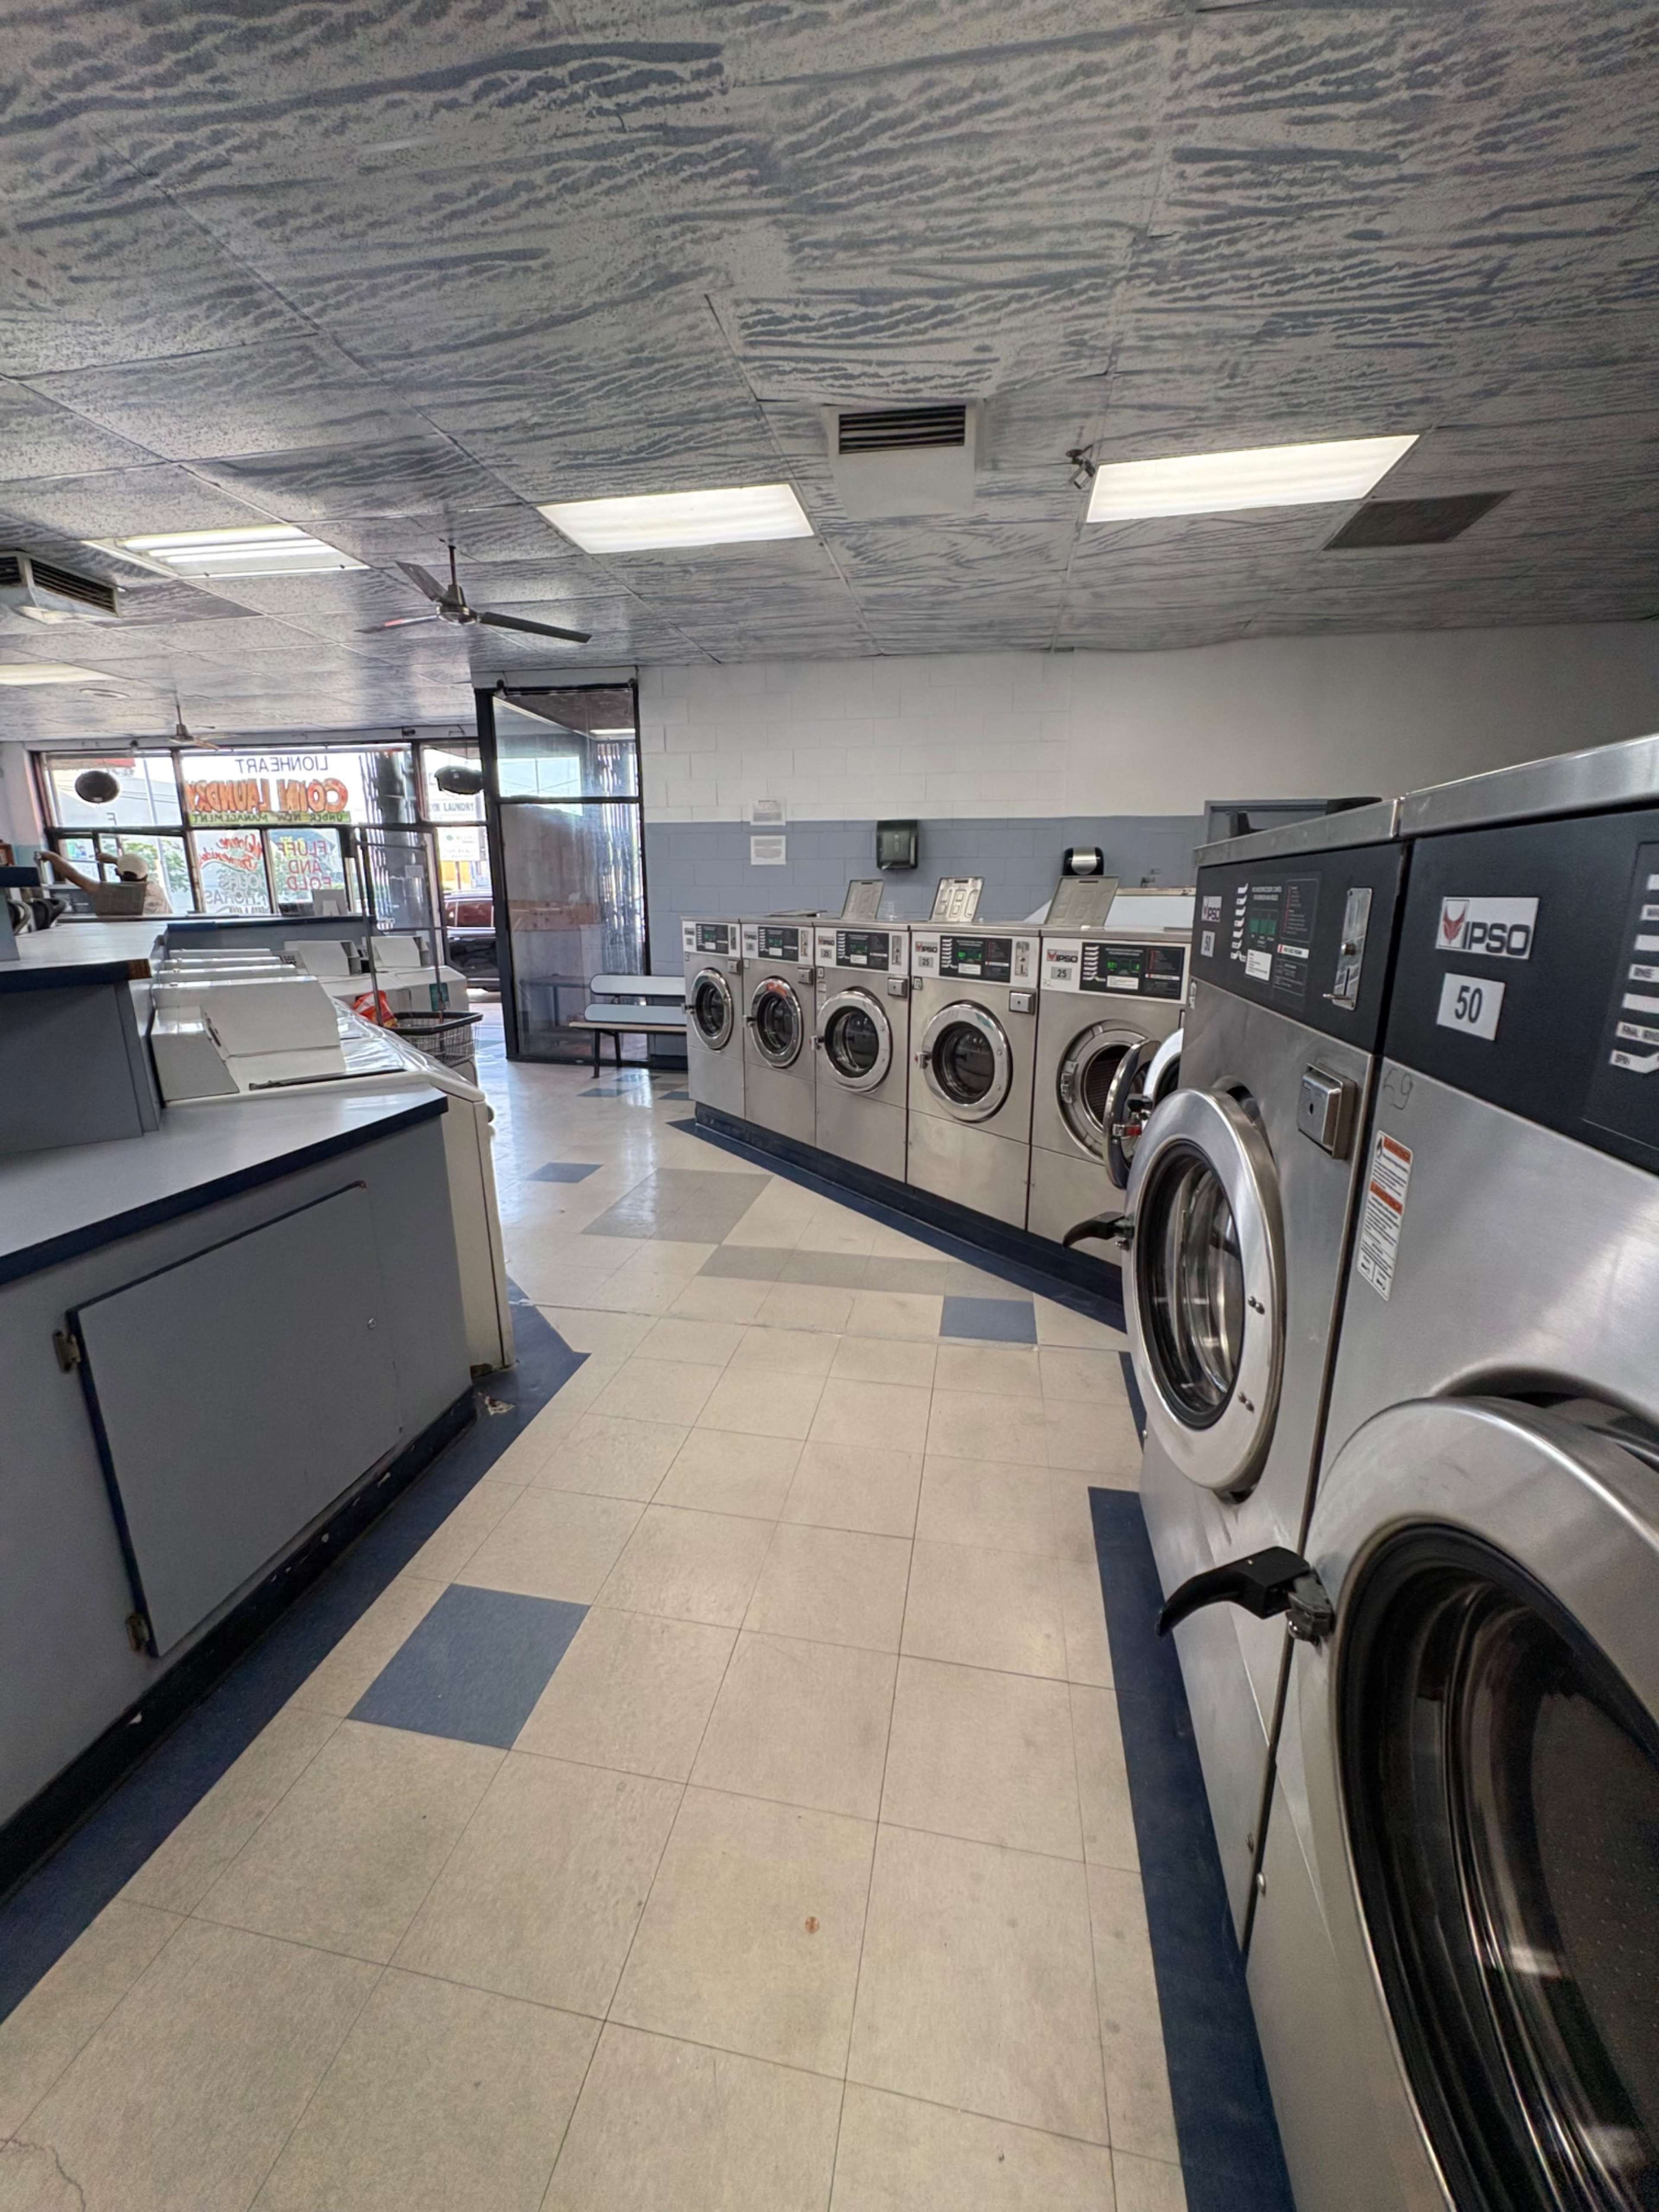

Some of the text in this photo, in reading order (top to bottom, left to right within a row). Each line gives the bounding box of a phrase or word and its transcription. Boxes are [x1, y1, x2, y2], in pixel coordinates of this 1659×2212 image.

[444, 802, 474, 812] LAUNDRY
[1462, 921, 1531, 957] IPSO
[922, 958, 929, 966] 25
[1056, 955, 1078, 963] IPSO
[1057, 969, 1067, 978] 25
[1454, 985, 1483, 1024] 50
